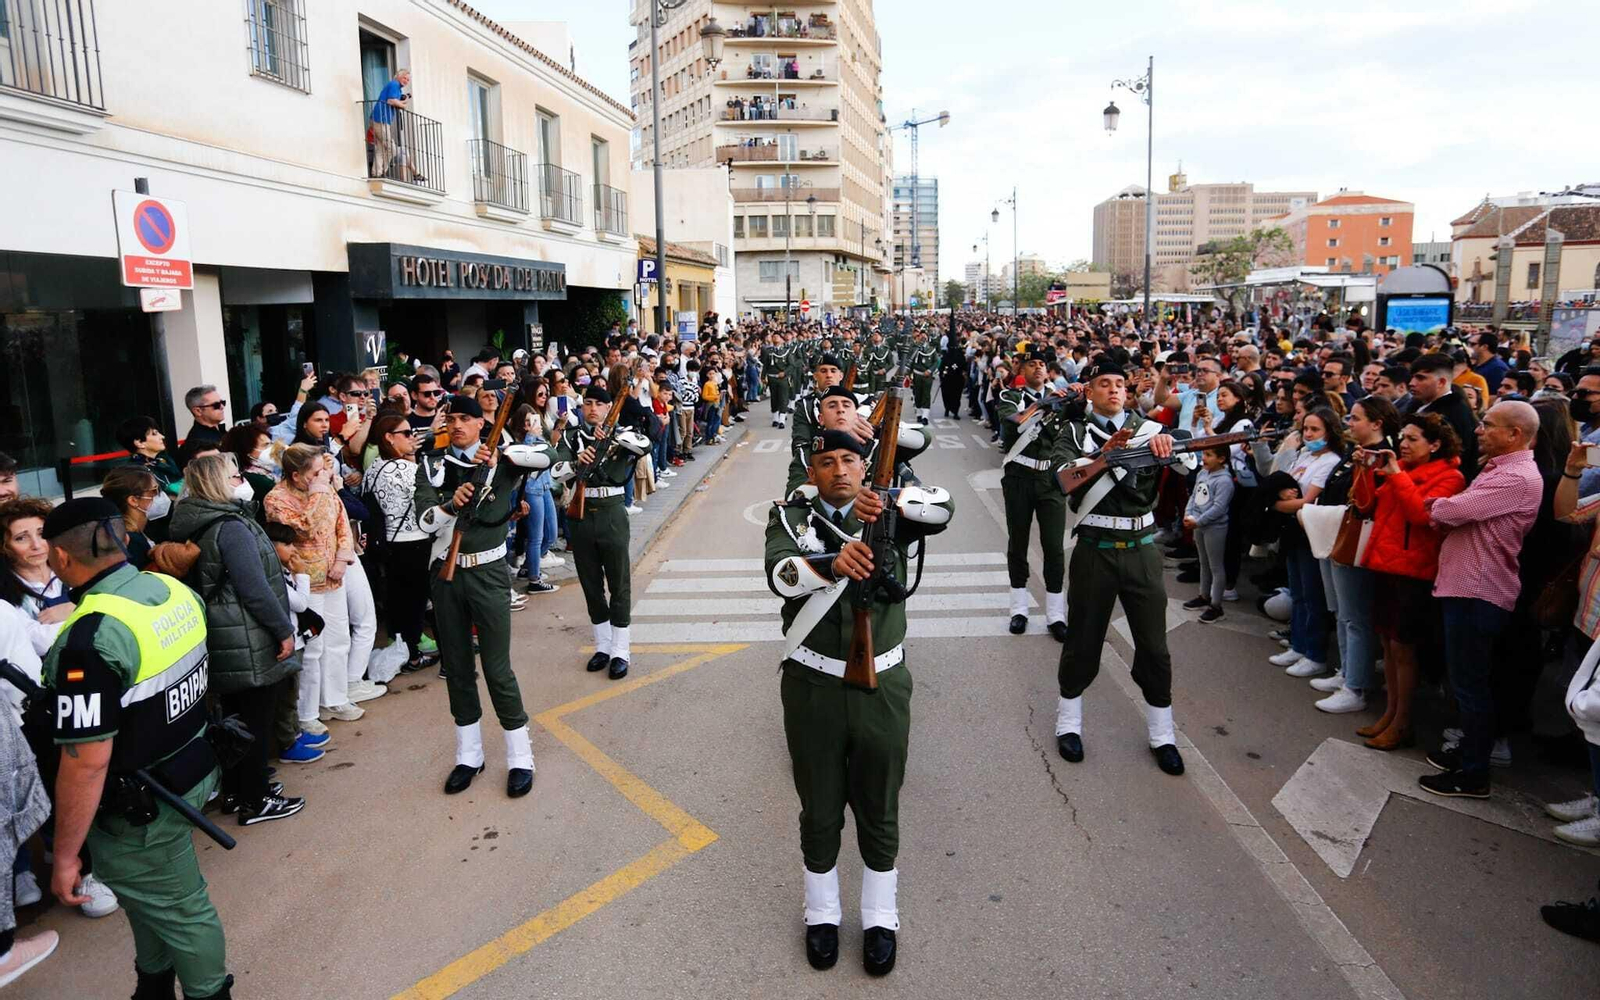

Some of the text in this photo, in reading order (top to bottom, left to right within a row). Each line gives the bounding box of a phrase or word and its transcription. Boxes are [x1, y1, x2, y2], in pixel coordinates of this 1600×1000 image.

[145, 259, 171, 267] EXCEPTO
[402, 255, 454, 288] HOTEL
[516, 267, 537, 291] DEL
[642, 260, 656, 278] P
[150, 276, 177, 284] VIAJEROS
[160, 615, 200, 650] MILITAR
[56, 692, 101, 730] PM
